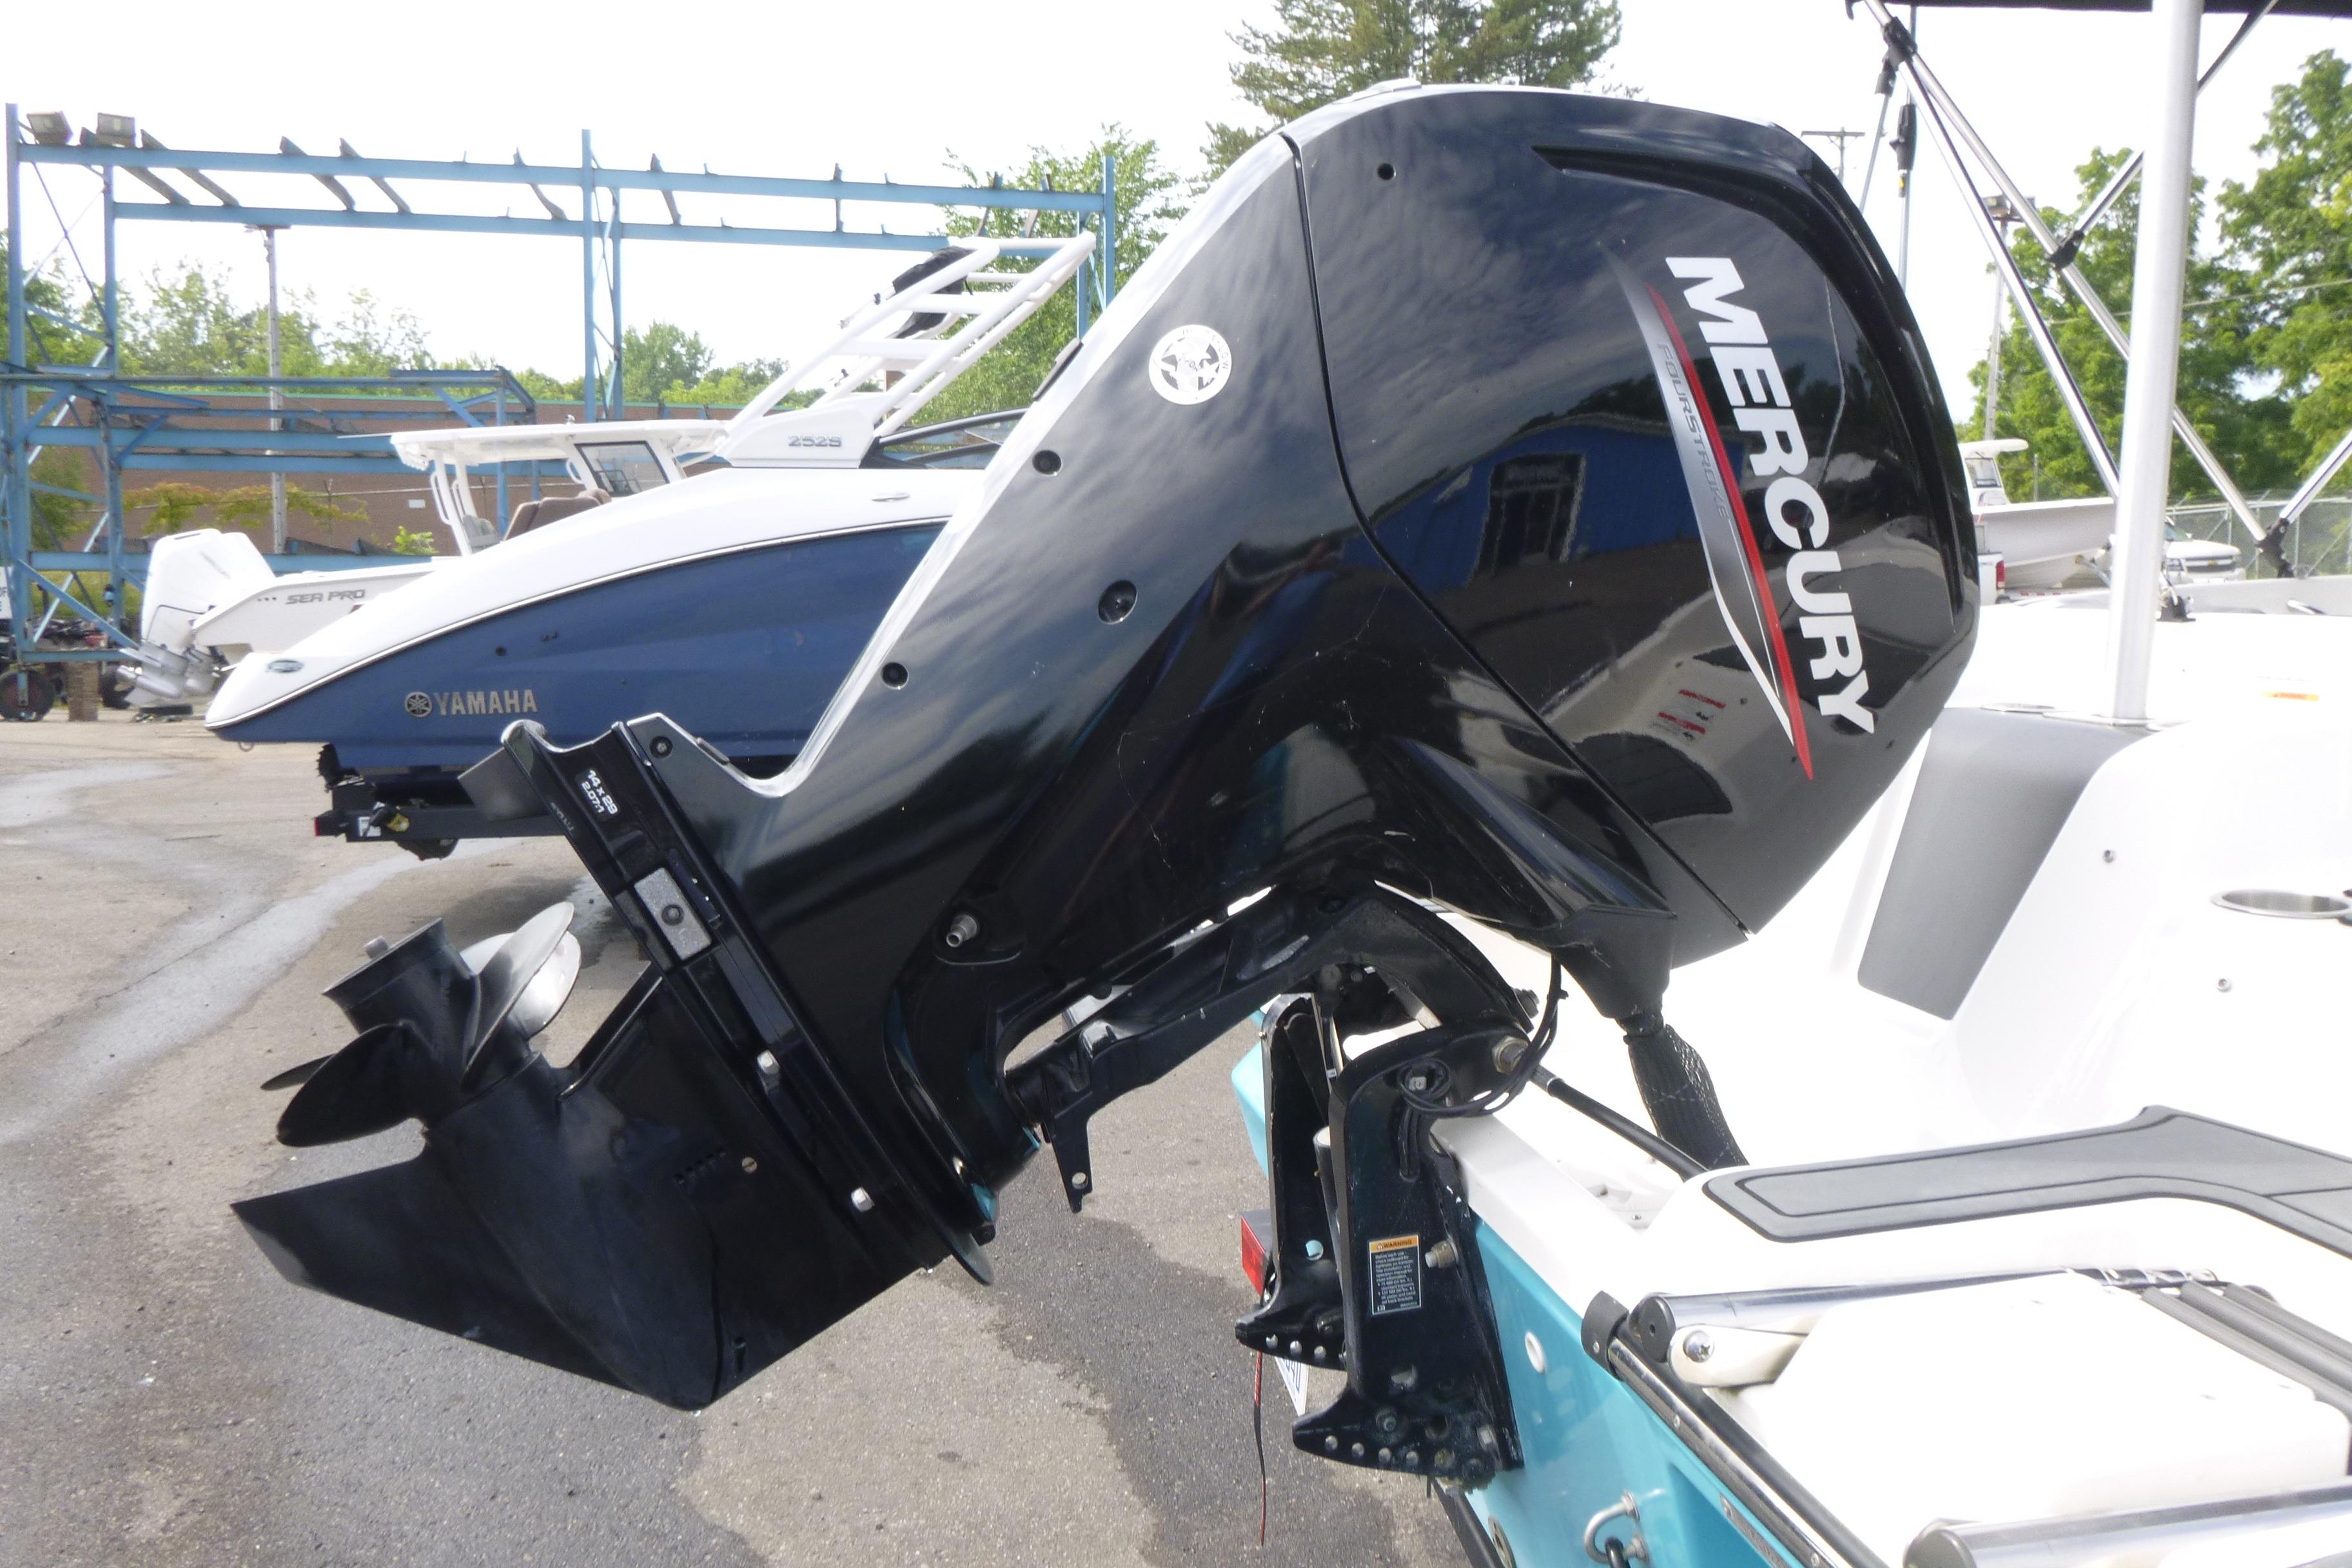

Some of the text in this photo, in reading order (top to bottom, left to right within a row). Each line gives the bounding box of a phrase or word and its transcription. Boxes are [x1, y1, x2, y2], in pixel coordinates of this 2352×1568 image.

[1656, 342, 1730, 519] FOURSTROKE
[1665, 257, 1875, 734] MERCURY
[285, 589, 366, 605] SEA PRO
[433, 689, 538, 716] YAMAHA
[588, 769, 601, 787] 14
[1383, 1239, 1412, 1248] WARNING
